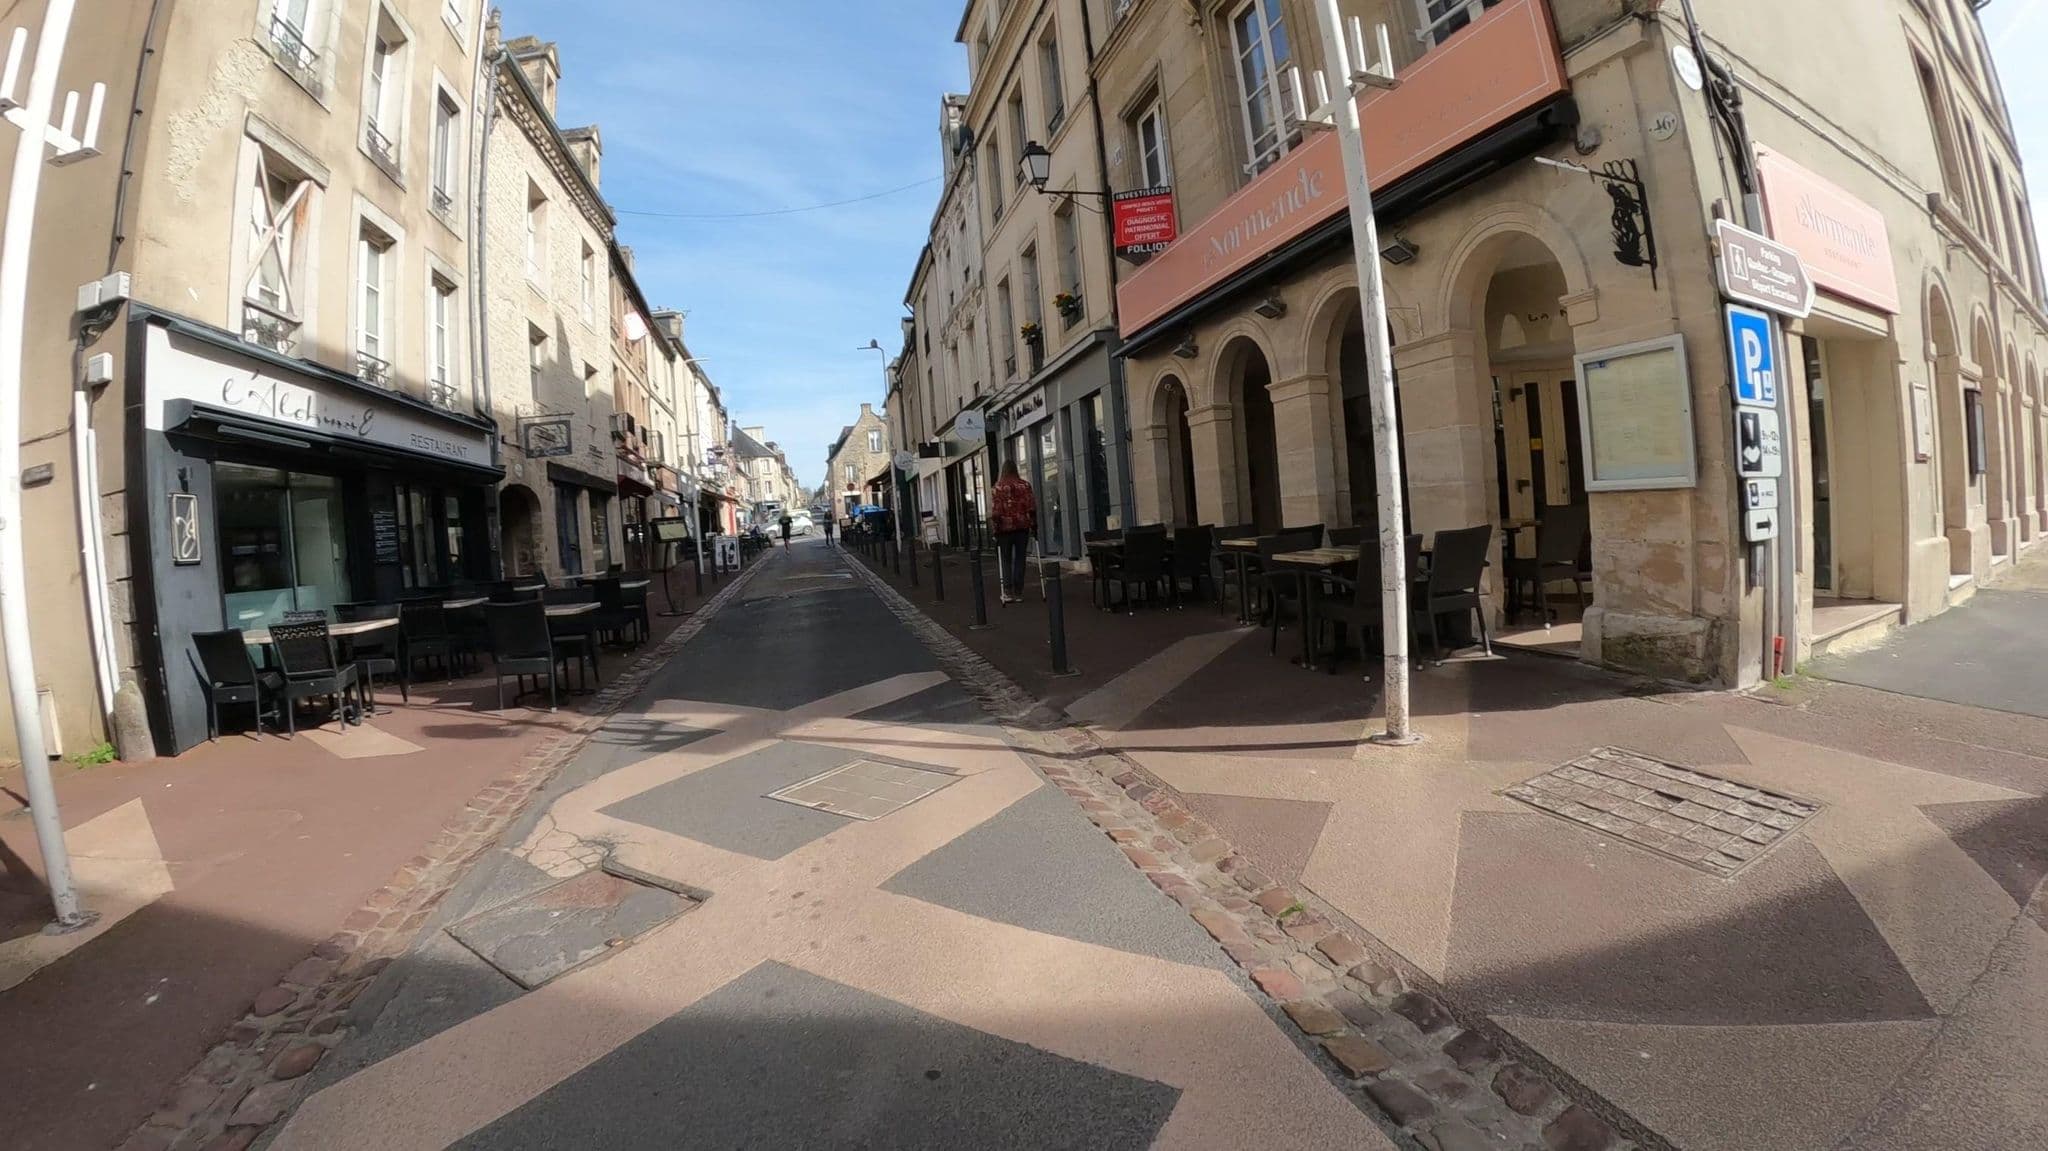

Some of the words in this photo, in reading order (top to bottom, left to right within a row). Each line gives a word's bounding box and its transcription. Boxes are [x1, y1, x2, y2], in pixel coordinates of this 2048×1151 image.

[1115, 187, 1171, 200] INVESTISSEUR
[1209, 167, 1324, 257] Normande
[1126, 215, 1168, 225] DIAGNOSTIC
[1124, 223, 1171, 234] PATRIMONIAL
[1134, 231, 1161, 241] OFFERT
[1127, 242, 1168, 254] FOLLIOT
[410, 433, 468, 458] RESTAURANT
